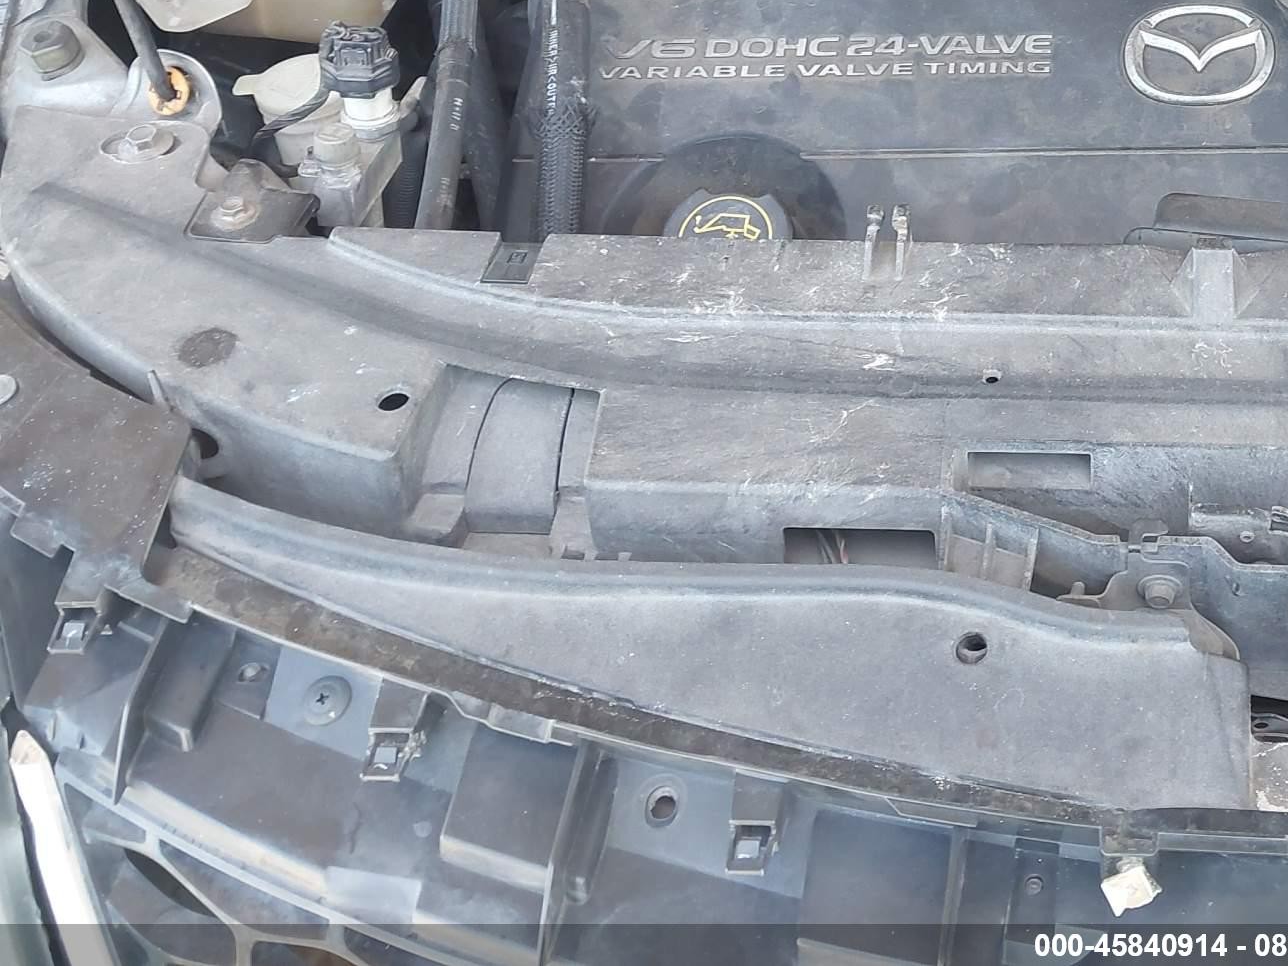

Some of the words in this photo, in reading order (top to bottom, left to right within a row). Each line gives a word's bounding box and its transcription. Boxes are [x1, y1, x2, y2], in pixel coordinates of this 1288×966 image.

[605, 38, 698, 59] V6
[704, 35, 841, 58] DOHC
[846, 33, 1054, 57] 24-VALVE
[600, 64, 786, 80] VARIABLE
[797, 62, 914, 77] VALVE
[923, 60, 1052, 75] TIMING
